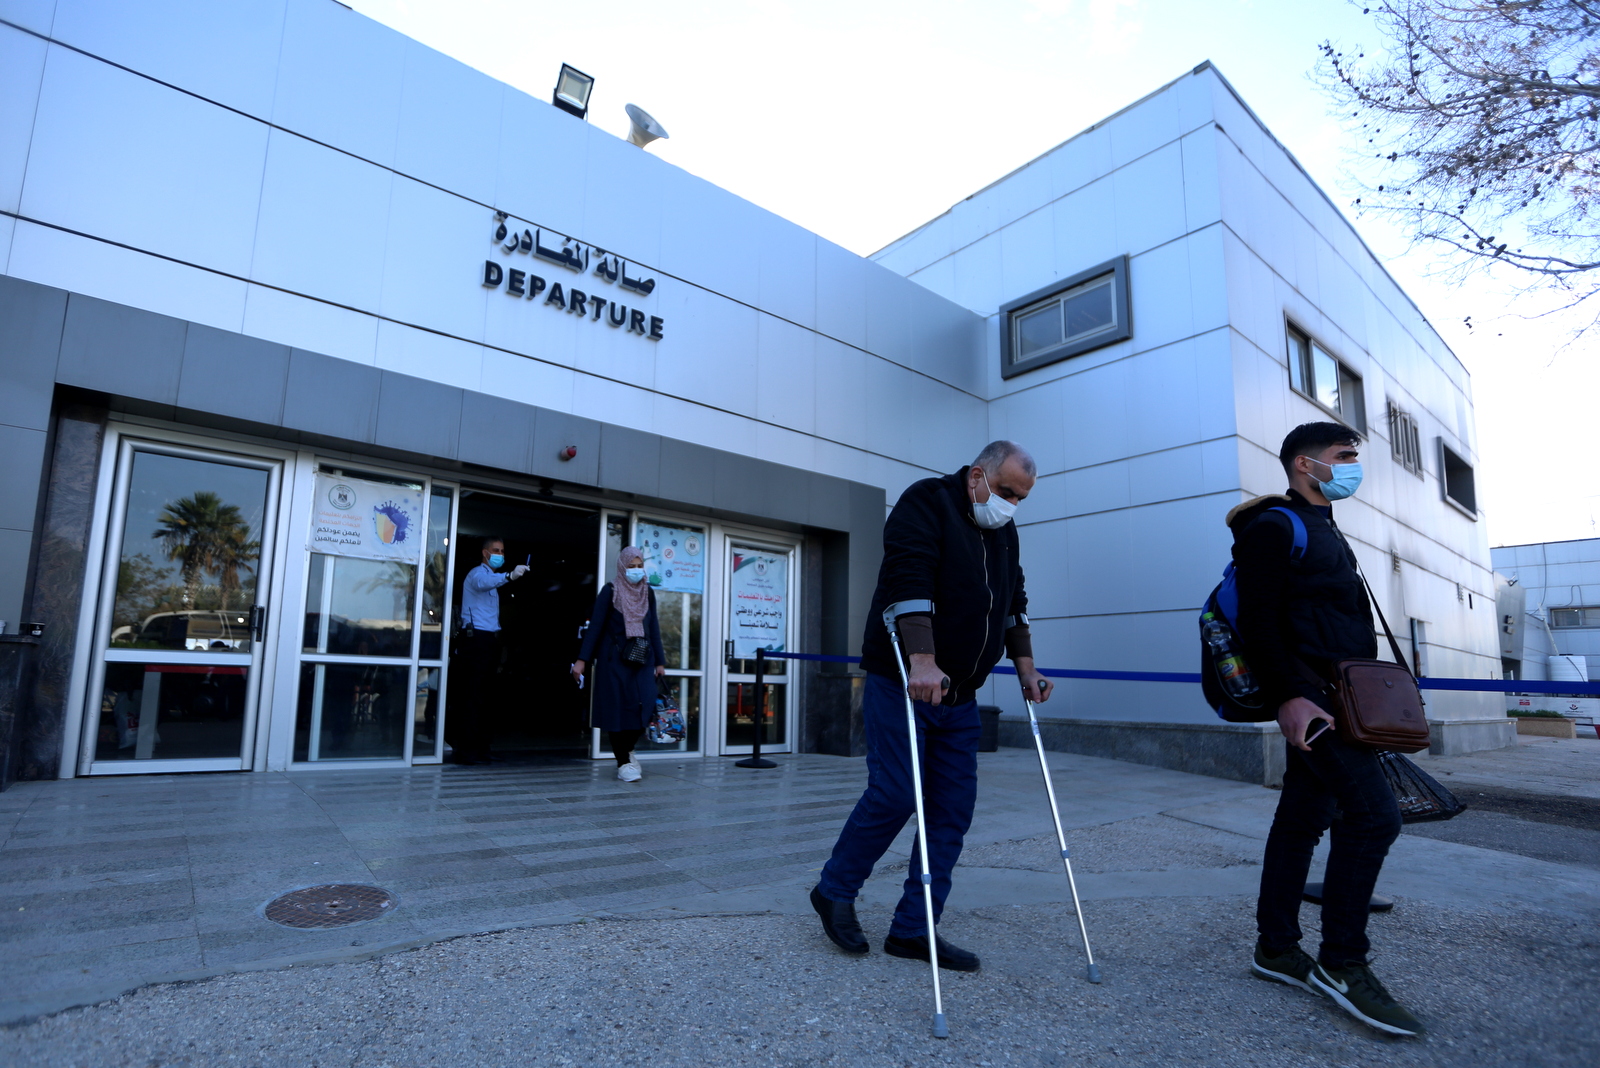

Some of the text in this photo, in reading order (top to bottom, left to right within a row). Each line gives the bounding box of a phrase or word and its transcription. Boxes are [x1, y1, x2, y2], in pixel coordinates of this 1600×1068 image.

[494, 210, 656, 297] صالة المغادرة
[482, 260, 664, 341] DEPARTURE
[314, 534, 339, 543] سالمين
[317, 526, 361, 538] يضمن عودتكم
